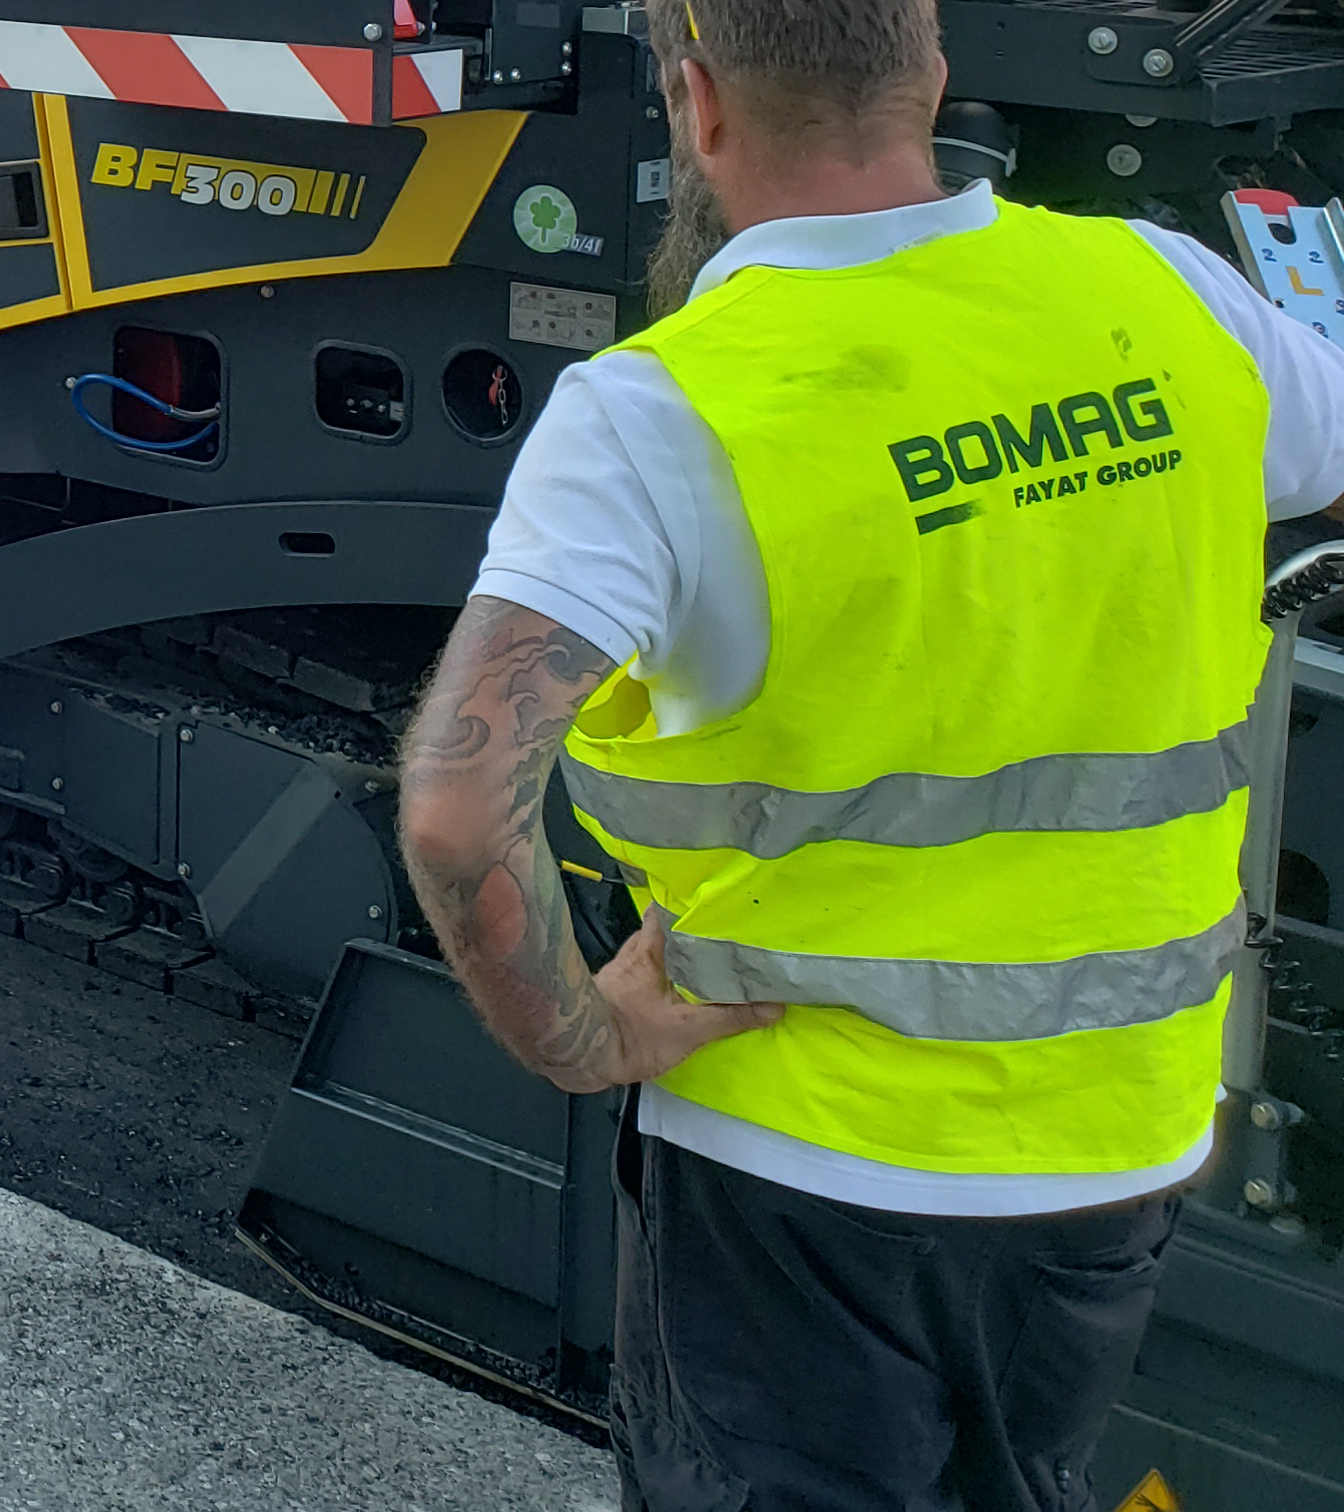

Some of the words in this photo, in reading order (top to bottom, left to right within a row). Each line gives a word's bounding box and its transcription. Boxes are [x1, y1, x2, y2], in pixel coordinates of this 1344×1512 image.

[887, 377, 1175, 504] BOMAG
[1013, 471, 1089, 509] FAYAT
[1096, 448, 1183, 487] GROUP
